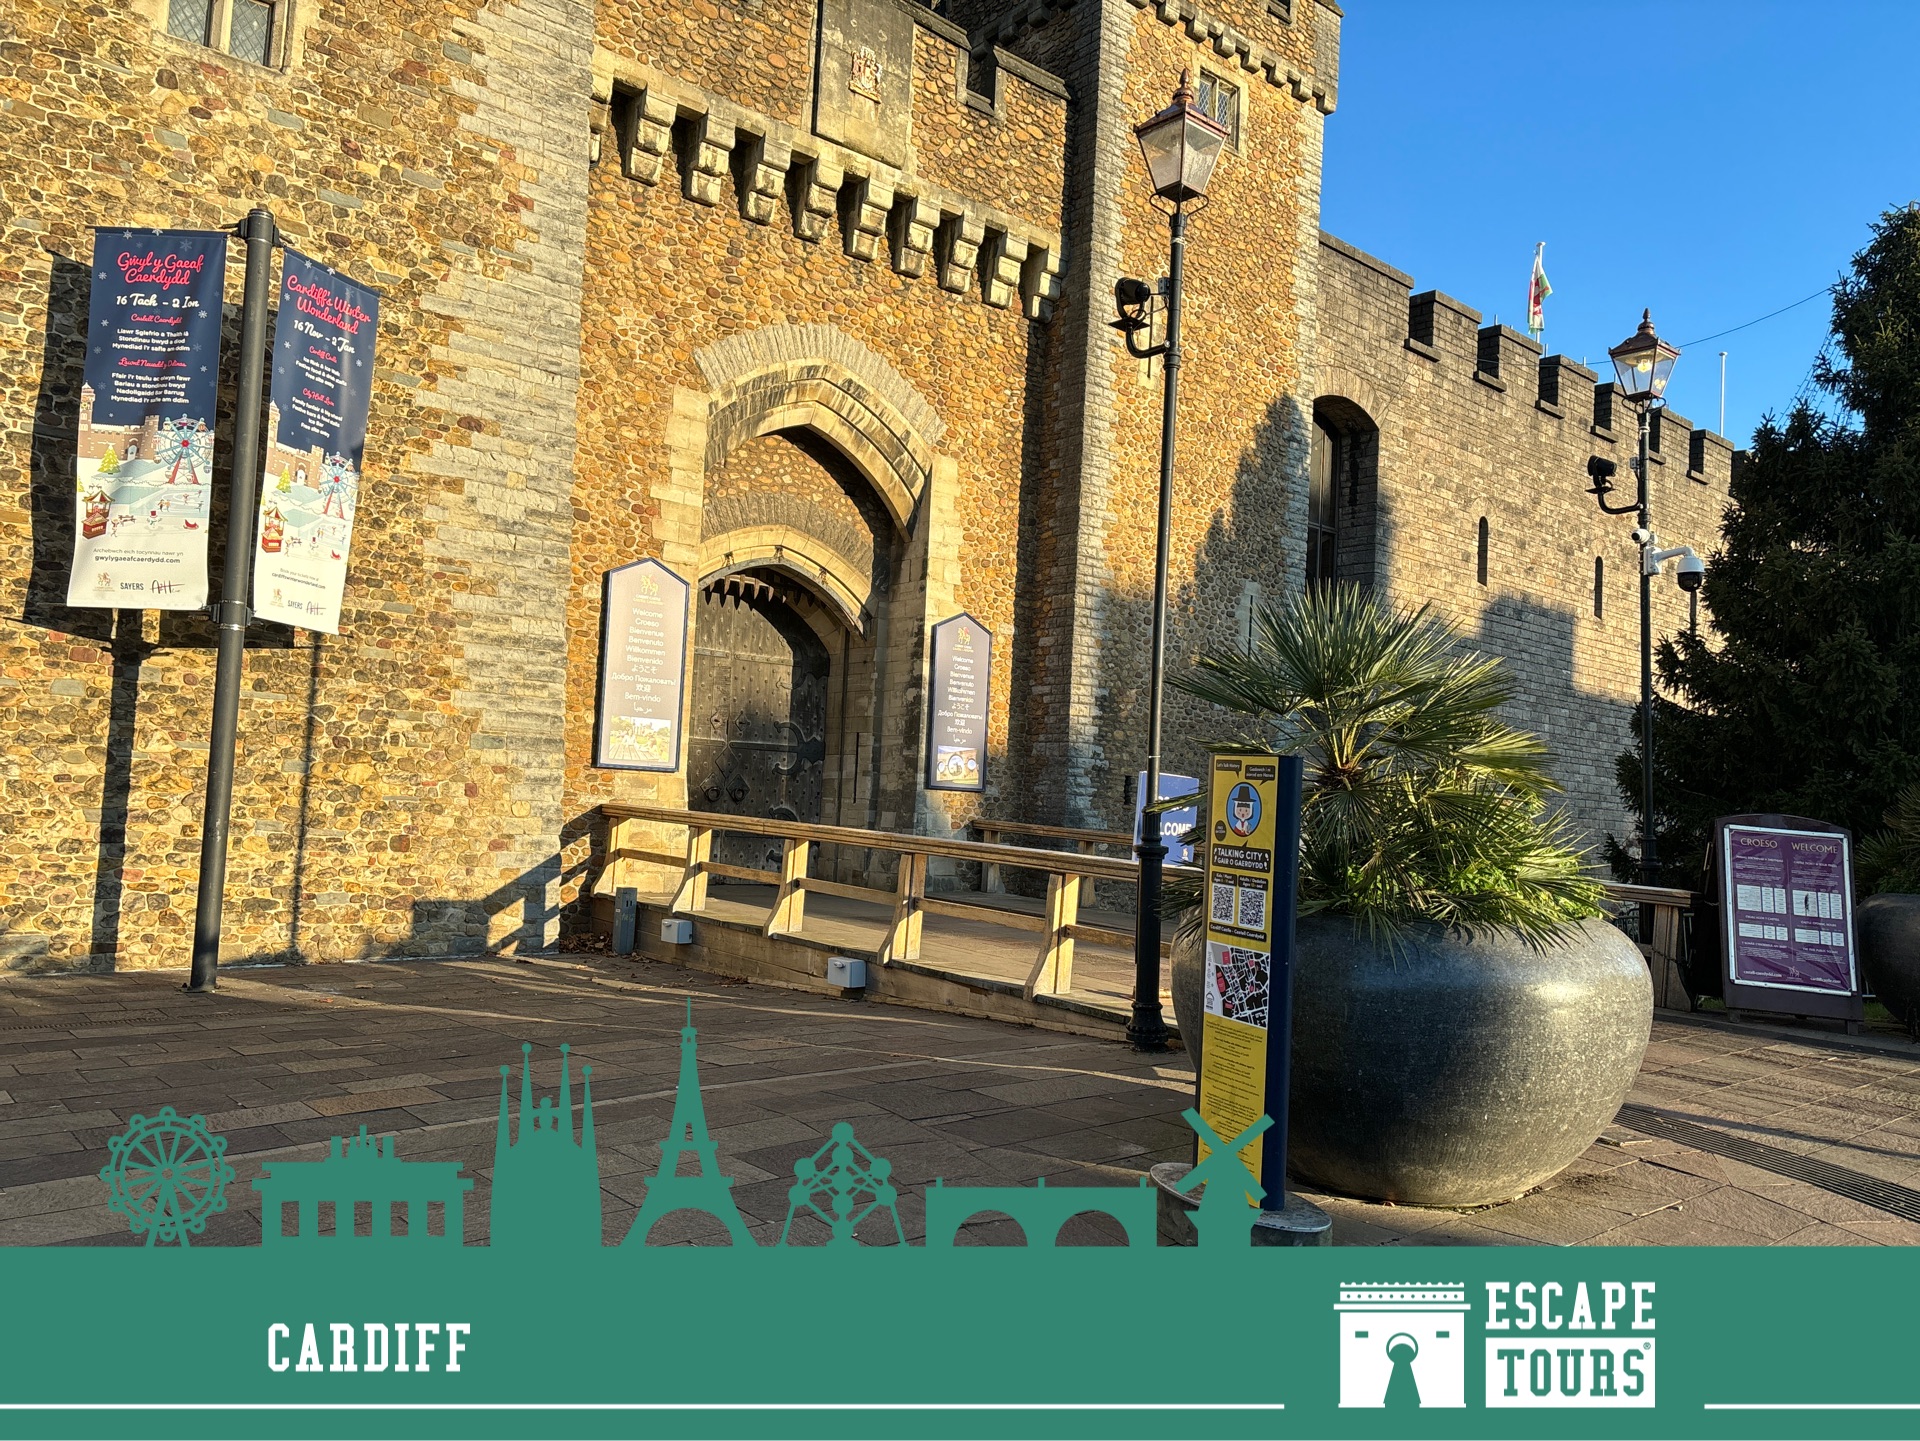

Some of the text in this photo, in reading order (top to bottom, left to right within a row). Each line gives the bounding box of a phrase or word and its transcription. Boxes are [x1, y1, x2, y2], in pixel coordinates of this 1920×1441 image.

[152, 258, 164, 273] y
[164, 254, 204, 273] Gaeaf
[125, 268, 190, 290] Caerdydd
[116, 295, 128, 305] 16
[129, 293, 158, 306] Tach
[172, 298, 180, 308] 2
[181, 296, 200, 308] Ion
[287, 275, 372, 323] Cardiff's Winter
[297, 296, 359, 335] Wonderland
[294, 320, 304, 332] 16
[304, 322, 324, 339] Nov
[332, 336, 338, 347] 2
[337, 337, 356, 354] Jan
[95, 555, 180, 564] gwylygaeafcaerdydd.com
[120, 582, 144, 591] SAYERS
[632, 608, 664, 619] Welcome
[635, 618, 660, 628] Croeso
[629, 626, 664, 638] Bienvenue
[628, 636, 664, 646] Benvenuto
[625, 645, 666, 657] Willkommen
[626, 654, 664, 666] Bienvenido
[952, 656, 974, 664] Welcome
[631, 664, 658, 674] ようこそ
[954, 664, 972, 672] Croeso
[612, 672, 634, 682] Добро
[950, 670, 974, 680] Bienvenue
[636, 683, 652, 692] 欢迎
[950, 678, 974, 688] Benvenuto
[952, 702, 970, 711] ようこそ
[938, 710, 954, 718] Добро
[1740, 837, 1778, 849] CROESO
[1791, 842, 1838, 854] WELCOME
[1218, 848, 1263, 861] TALKING CITY
[1234, 860, 1264, 870] GAERDYDD
